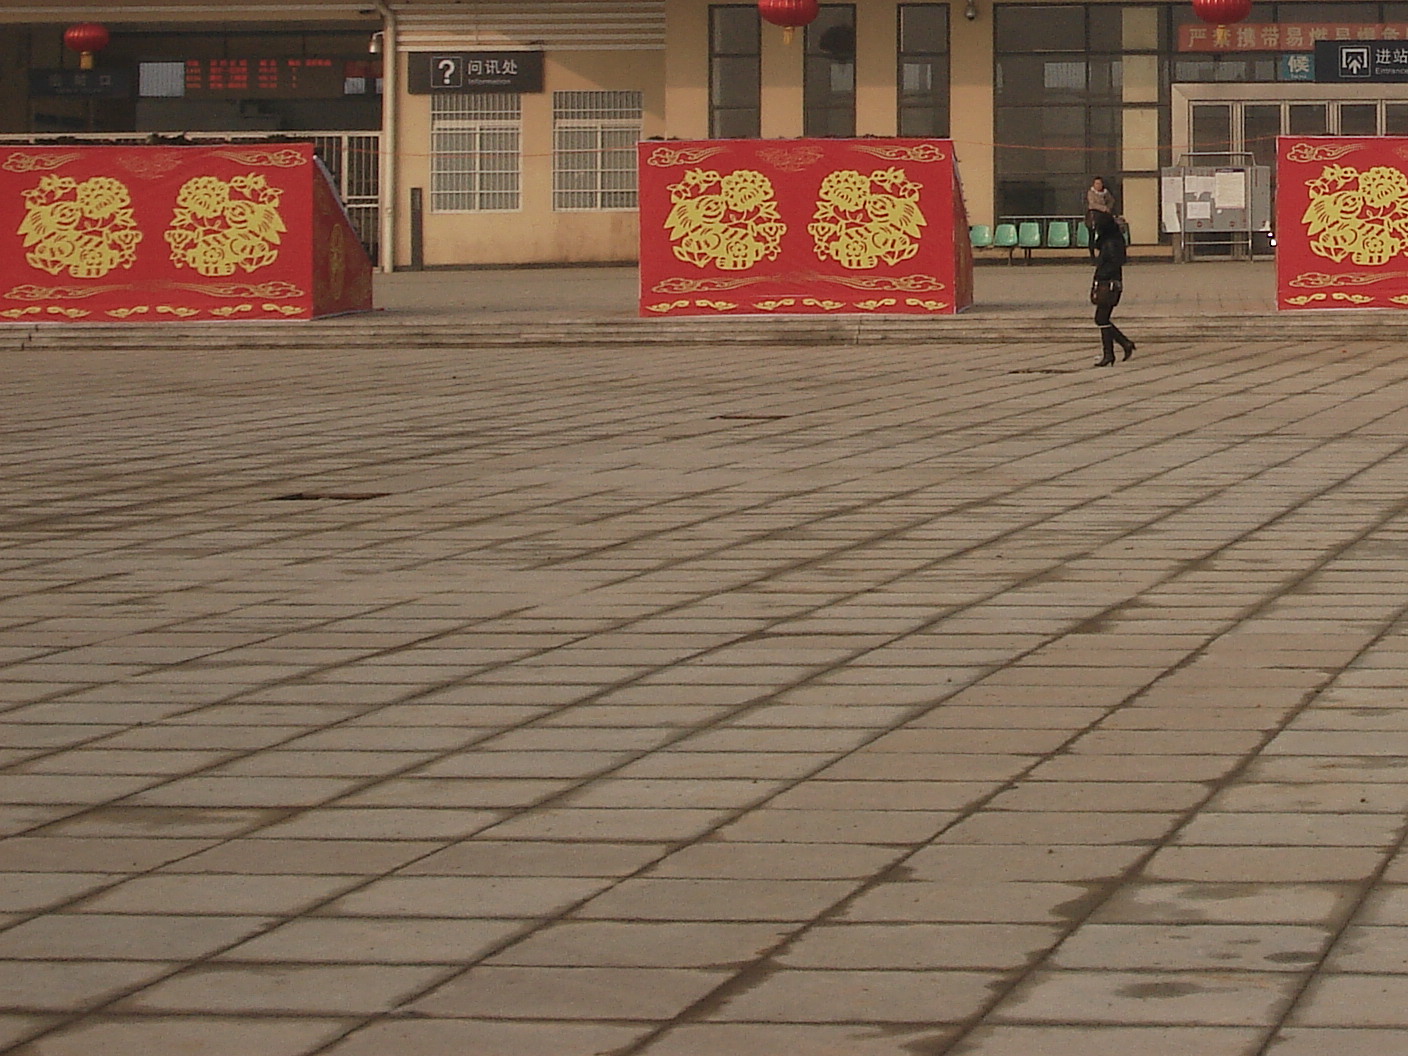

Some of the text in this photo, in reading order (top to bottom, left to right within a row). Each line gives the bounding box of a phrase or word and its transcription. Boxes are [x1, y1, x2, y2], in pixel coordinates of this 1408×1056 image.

[467, 59, 518, 75] 问讯处
[1287, 55, 1309, 73] 候
